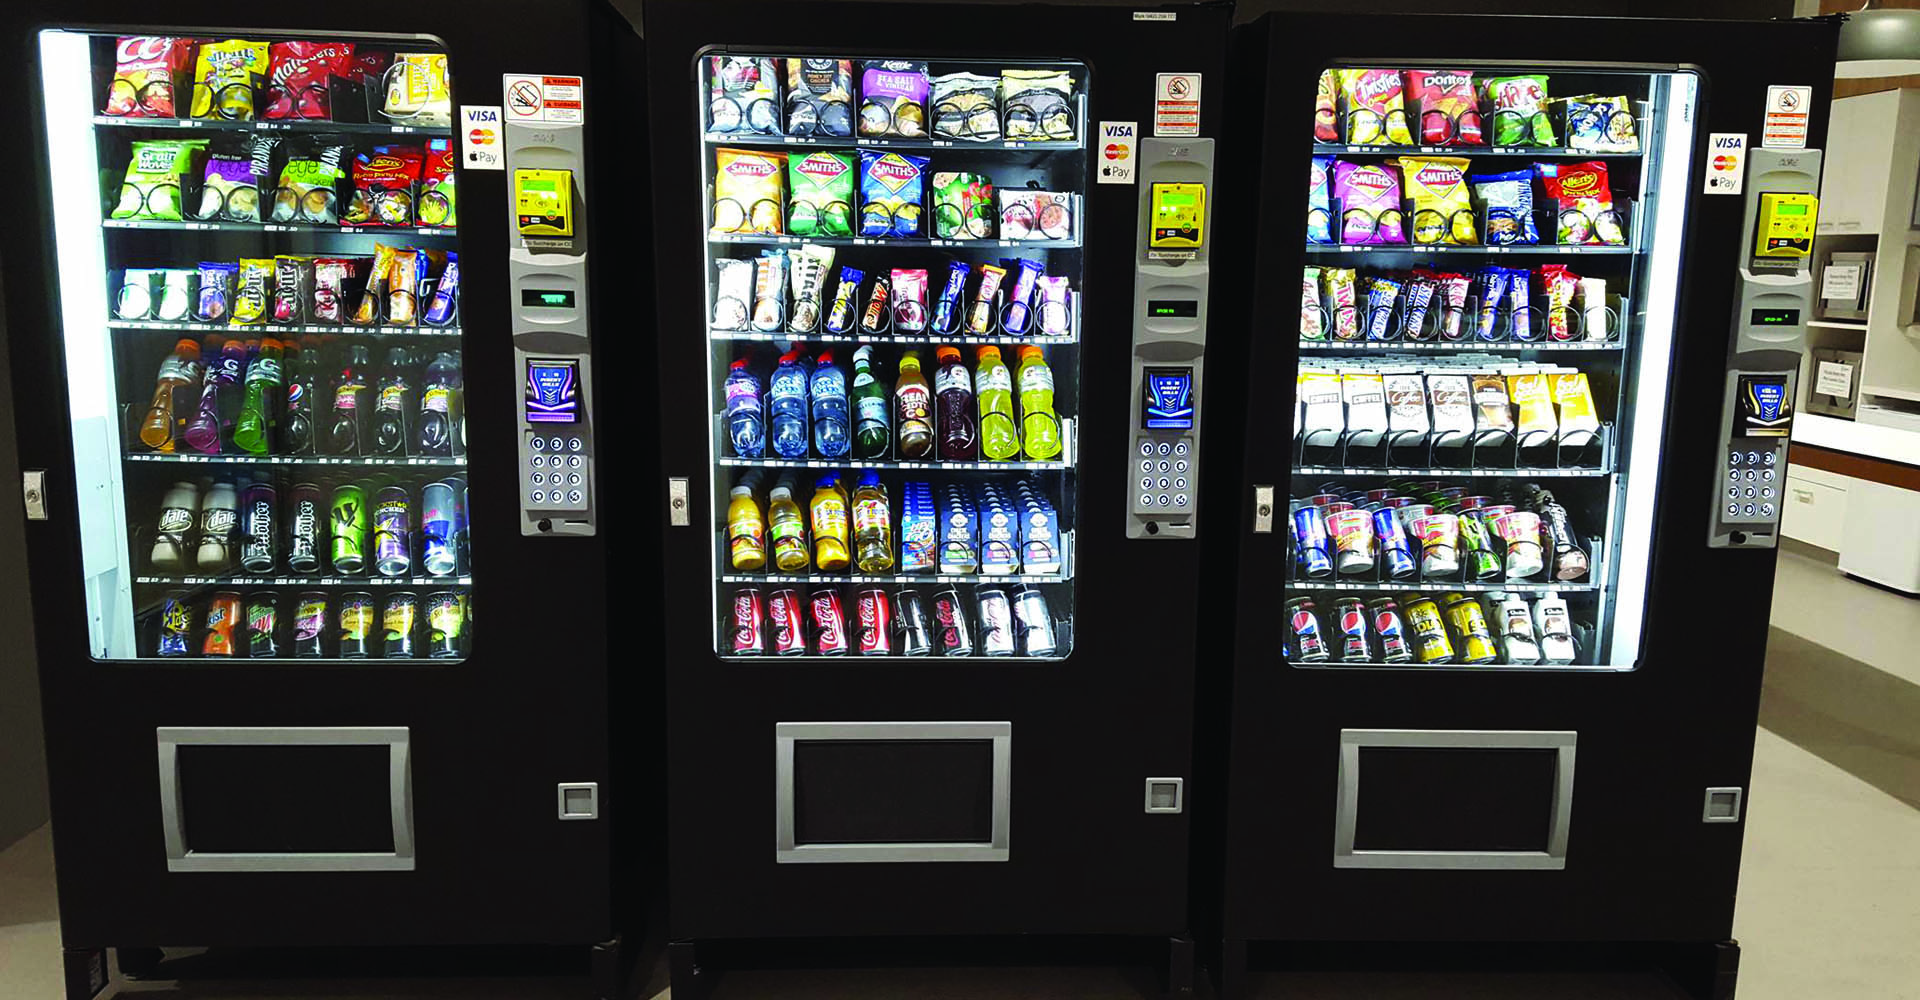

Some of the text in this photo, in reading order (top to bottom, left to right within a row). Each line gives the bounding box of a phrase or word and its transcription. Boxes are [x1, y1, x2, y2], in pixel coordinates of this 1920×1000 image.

[1356, 73, 1401, 97] Twisties
[1424, 75, 1472, 88] Doritos
[468, 110, 497, 122] VISA
[1105, 126, 1133, 137] VISA
[1715, 138, 1742, 149] VISA
[479, 151, 497, 165] Pay
[138, 161, 174, 170] Waves
[731, 164, 772, 175] SMITH'S
[801, 160, 843, 172] SMITH'S
[875, 161, 914, 177] SMITH'S
[1112, 166, 1130, 179] Pay
[1420, 169, 1462, 182] SMITH'S
[1351, 174, 1391, 186] SMITH'S
[1561, 174, 1595, 187] Allen's
[1719, 177, 1737, 190] Pay
